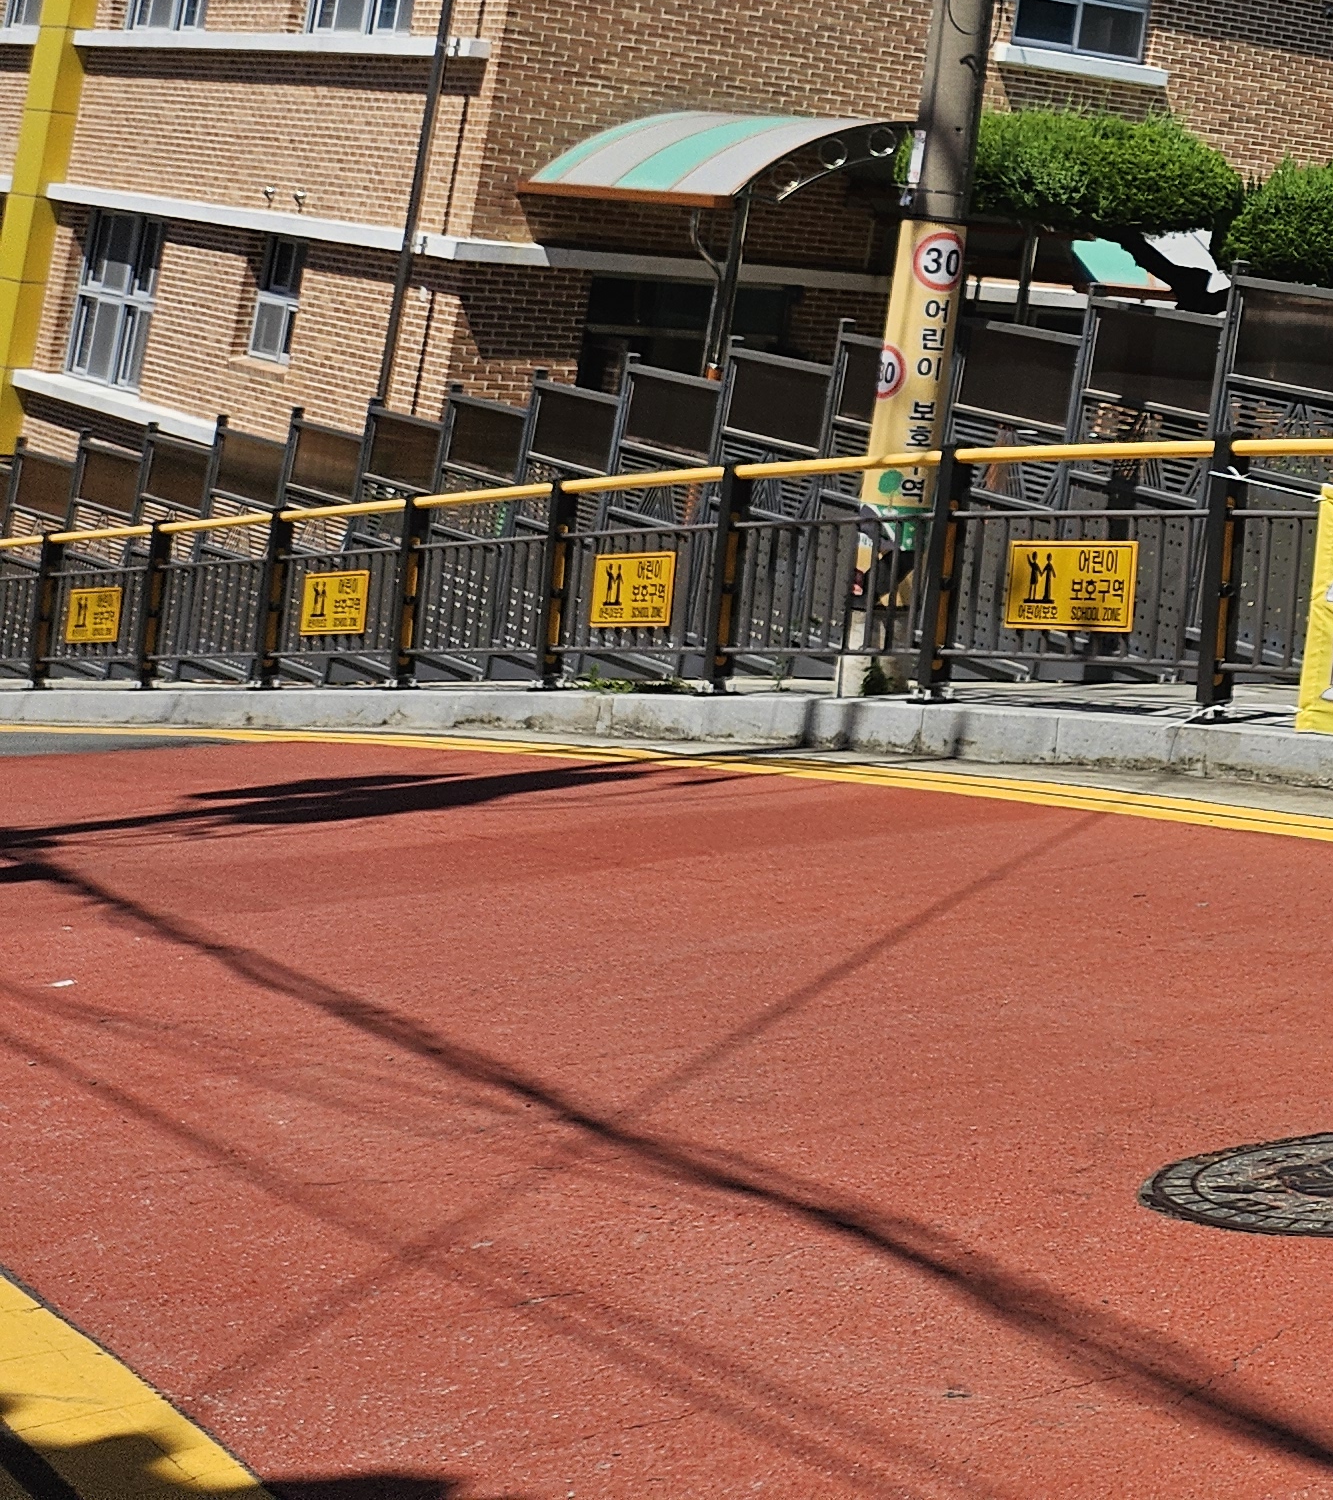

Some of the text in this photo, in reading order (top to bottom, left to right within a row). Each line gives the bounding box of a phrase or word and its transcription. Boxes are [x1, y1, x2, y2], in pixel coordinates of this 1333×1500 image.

[924, 248, 960, 277] 30
[901, 300, 950, 503] 어린이 보호역
[1078, 549, 1119, 575] 어린이
[1069, 578, 1125, 603] 보호구역
